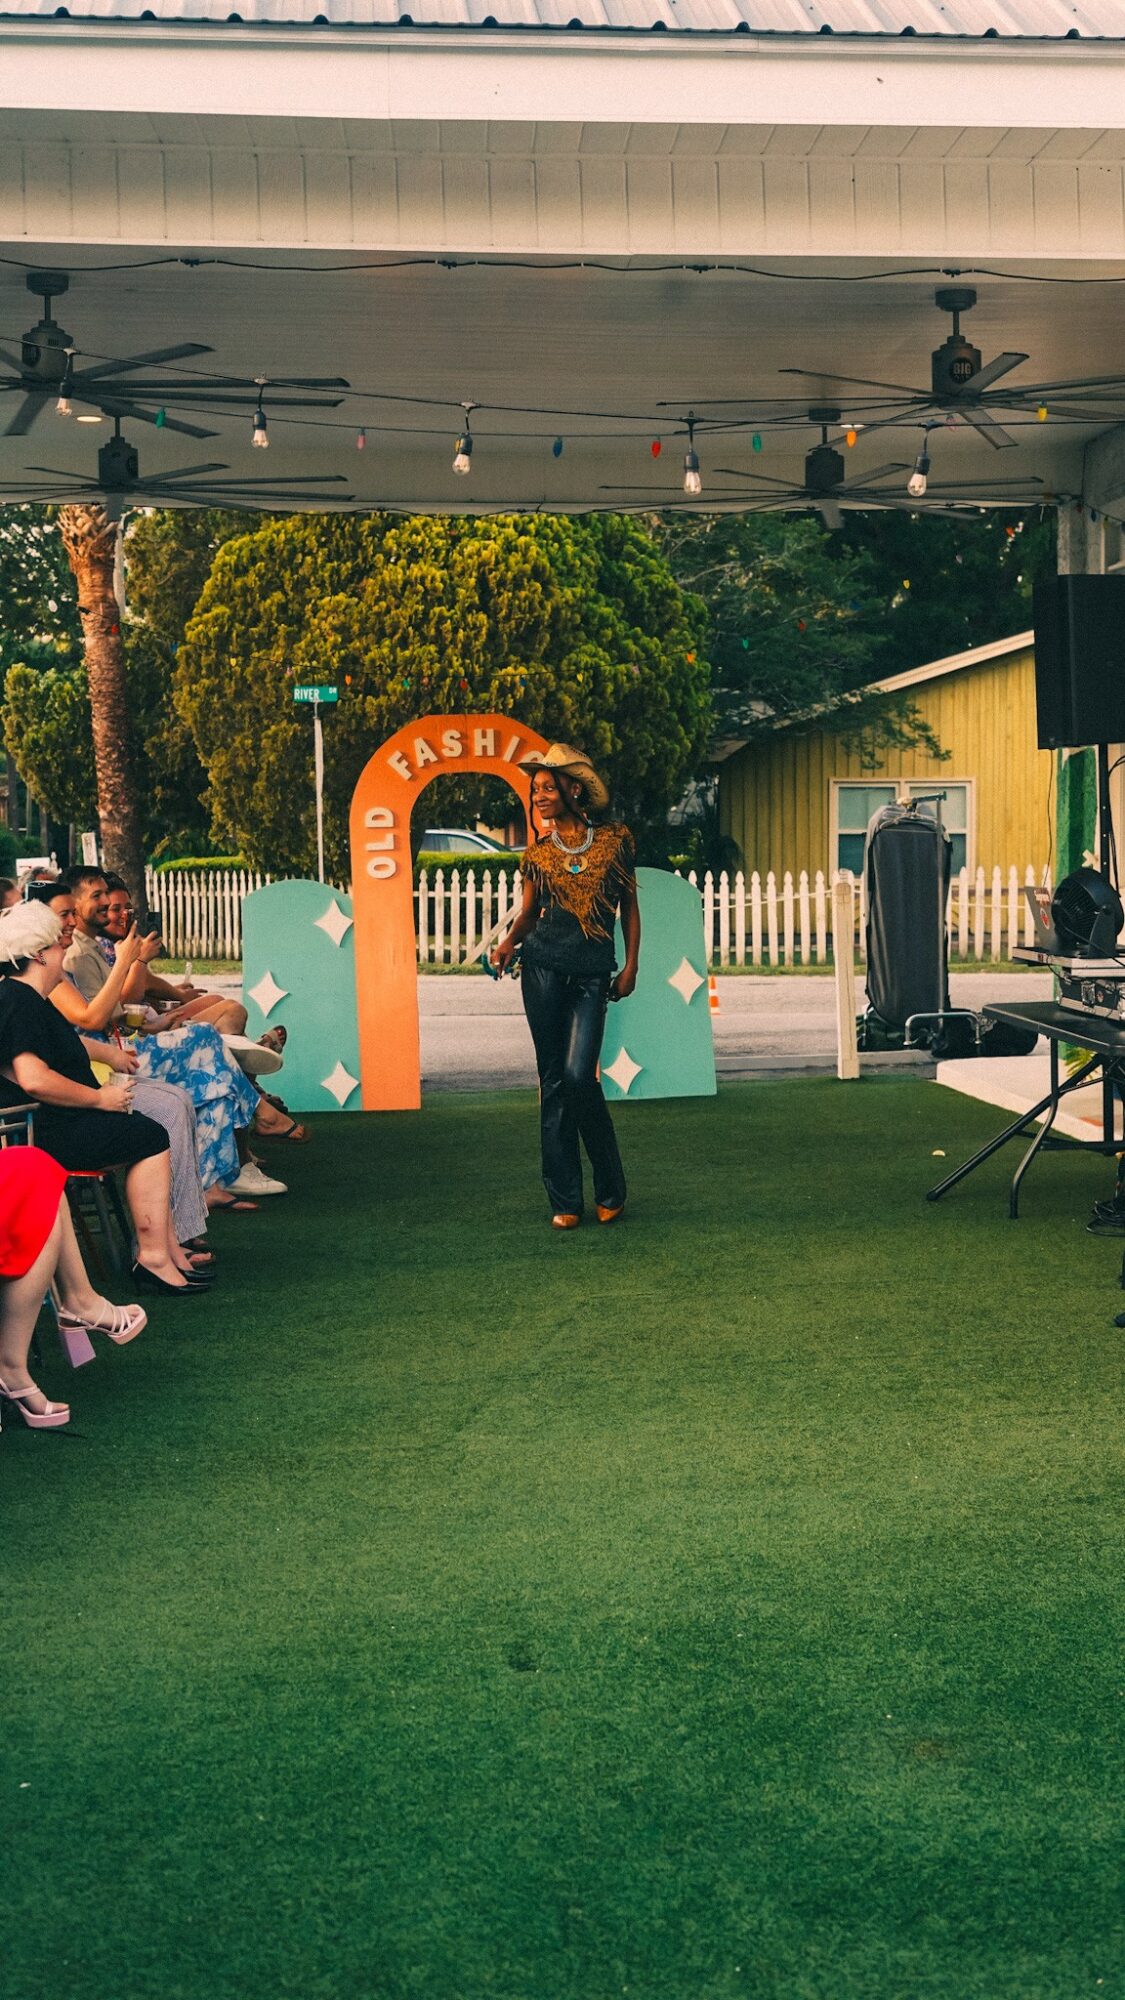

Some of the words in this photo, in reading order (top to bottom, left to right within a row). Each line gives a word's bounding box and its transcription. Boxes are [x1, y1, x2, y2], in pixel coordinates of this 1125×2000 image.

[953, 362, 971, 374] BIG
[294, 688, 320, 700] RIVER
[364, 806, 397, 880] OLD
